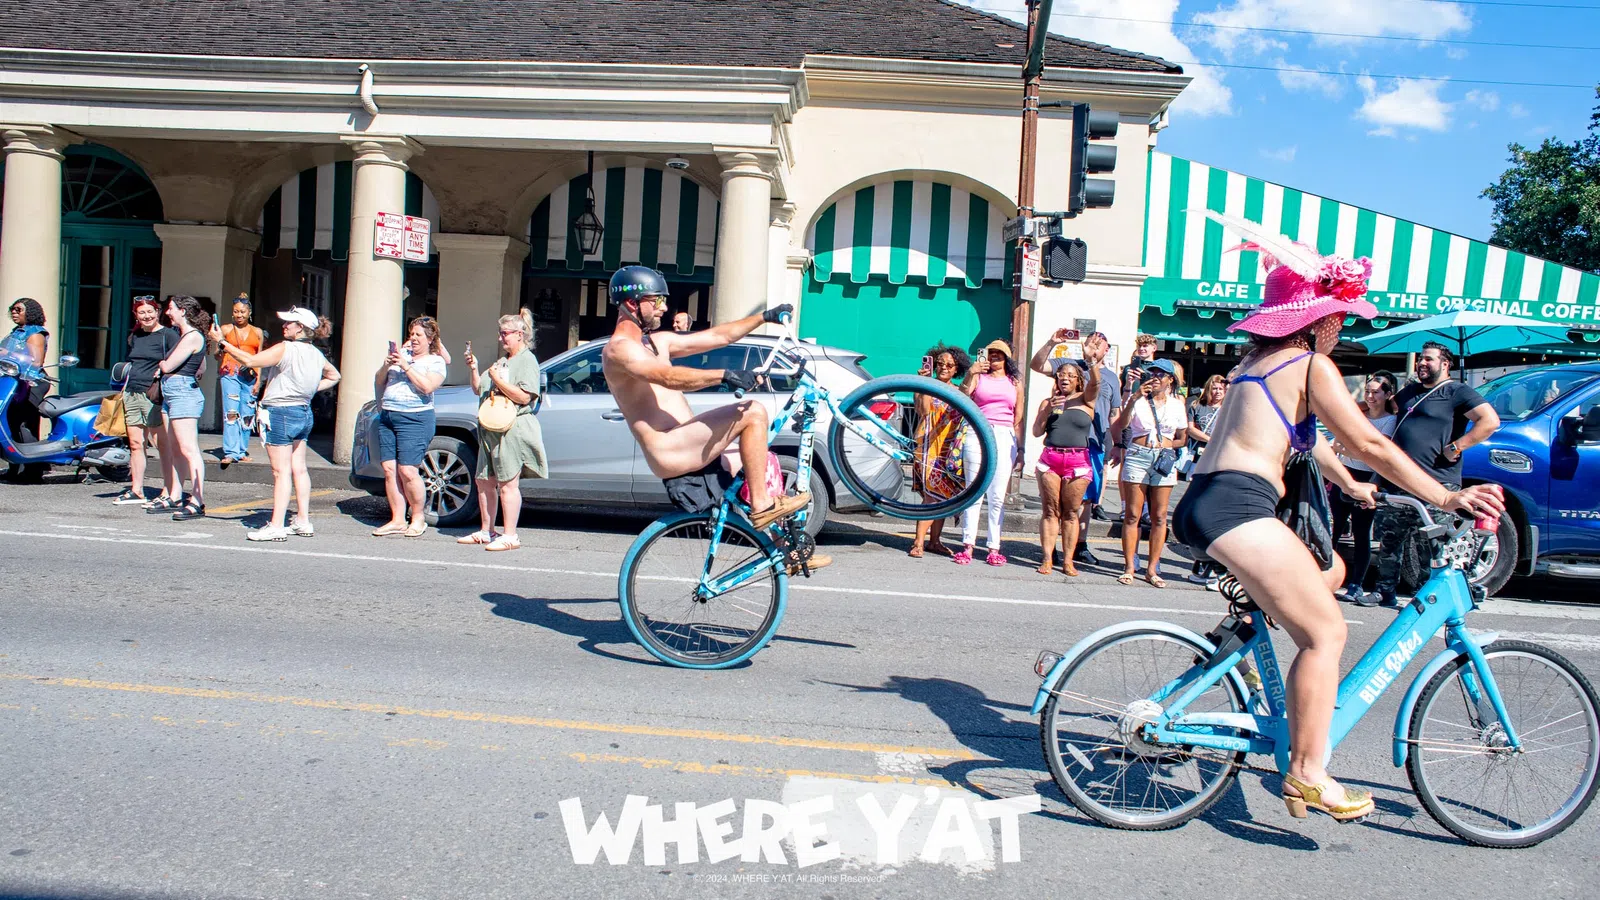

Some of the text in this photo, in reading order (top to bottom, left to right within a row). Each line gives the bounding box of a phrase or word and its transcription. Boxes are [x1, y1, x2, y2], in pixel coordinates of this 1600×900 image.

[409, 232, 424, 241] ANY
[409, 240, 424, 249] TIME
[1026, 260, 1036, 268] ANY
[1197, 282, 1248, 298] CAFE
[1387, 293, 1429, 309] THE
[1258, 642, 1286, 709] ELECTRIC
[1359, 631, 1422, 704] BLUE Bikes
